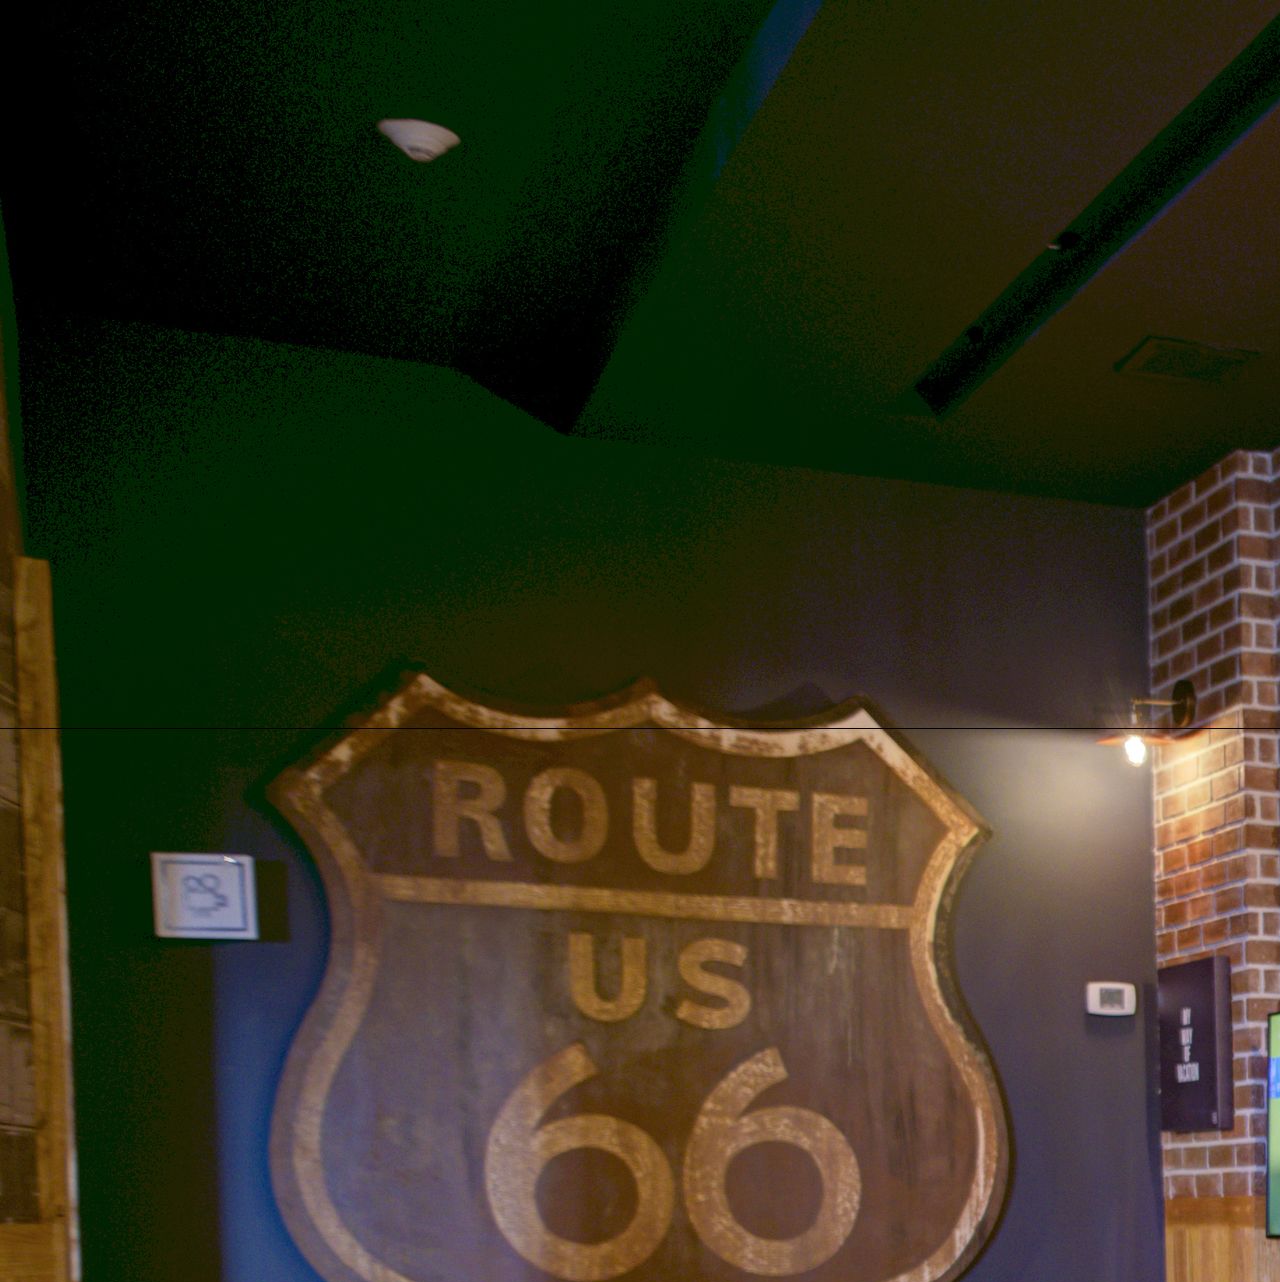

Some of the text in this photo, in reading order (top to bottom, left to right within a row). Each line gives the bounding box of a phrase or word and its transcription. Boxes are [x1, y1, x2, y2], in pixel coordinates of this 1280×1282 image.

[431, 760, 870, 887] ROUTE
[567, 932, 752, 1030] US
[485, 1042, 862, 1282] 66
